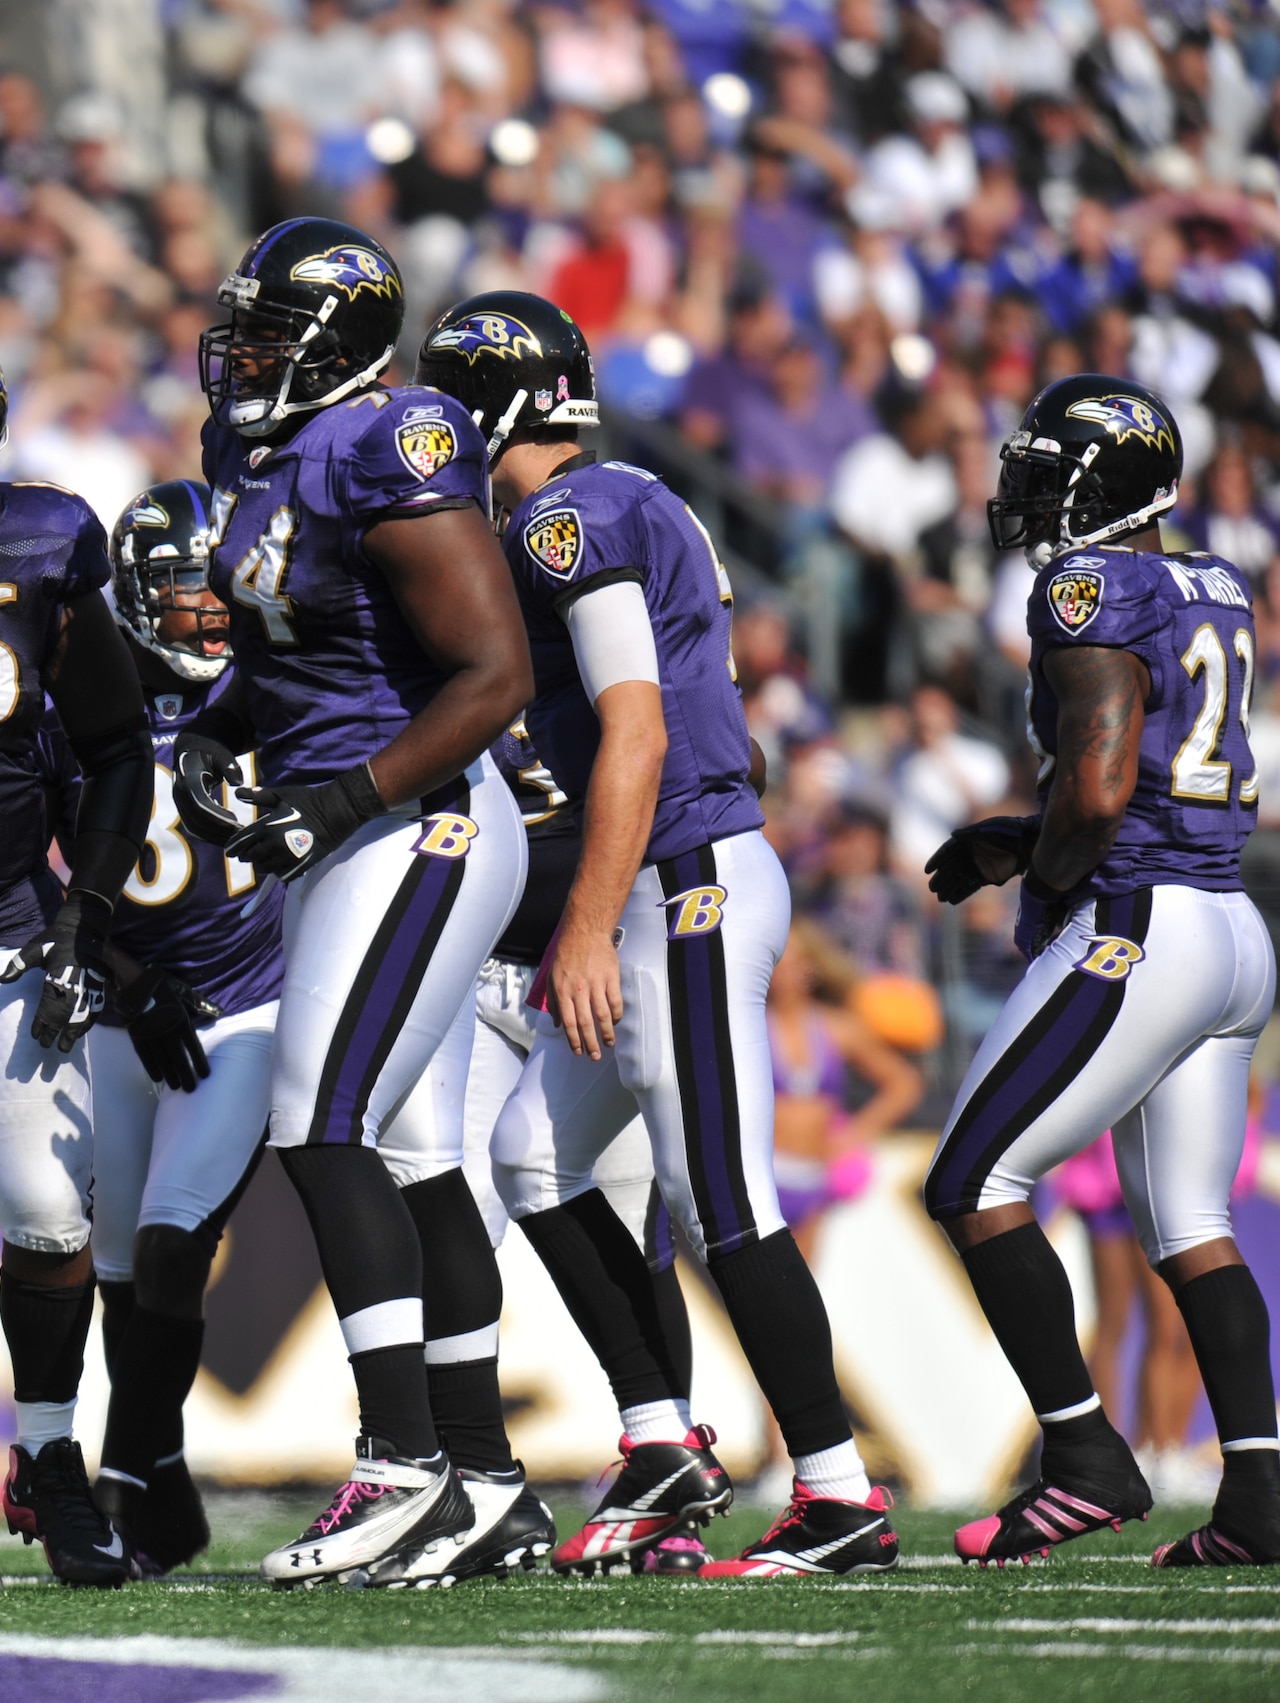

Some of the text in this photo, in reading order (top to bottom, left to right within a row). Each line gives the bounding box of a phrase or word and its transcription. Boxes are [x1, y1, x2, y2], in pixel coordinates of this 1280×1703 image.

[357, 254, 382, 281] B
[482, 315, 509, 343] B
[566, 407, 598, 417] RAVE
[1132, 404, 1155, 433] B
[402, 423, 447, 437] RAVENS
[529, 514, 570, 535] RAVENS
[1056, 574, 1097, 585] RAVENS
[151, 734, 179, 745] RAV
[408, 810, 480, 860] B
[657, 884, 728, 941] B
[1073, 934, 1146, 982] B
